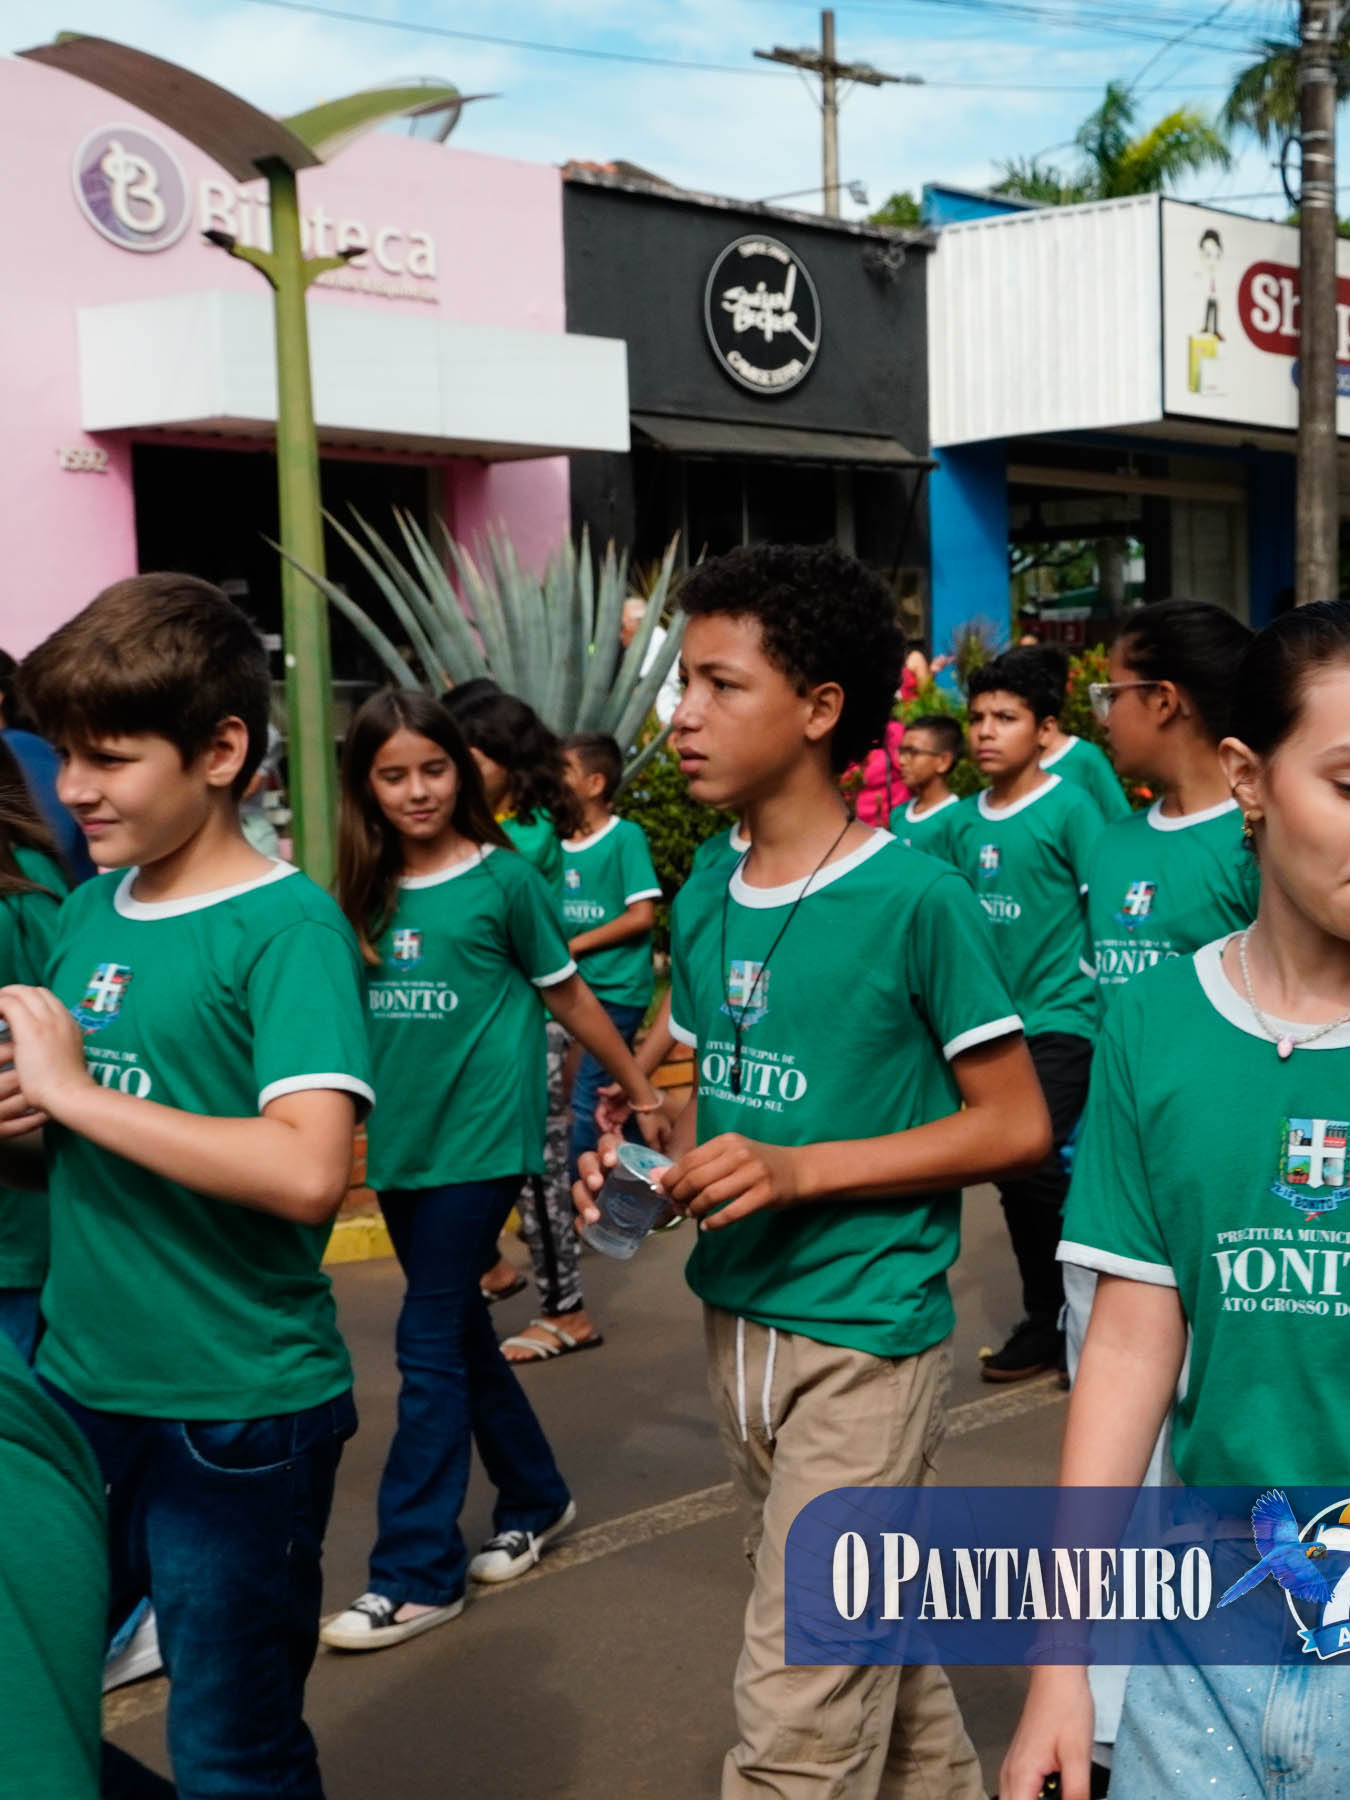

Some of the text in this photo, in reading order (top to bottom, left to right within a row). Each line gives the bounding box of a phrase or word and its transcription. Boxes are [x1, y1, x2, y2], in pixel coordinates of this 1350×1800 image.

[368, 989, 459, 1012] BONITO
[702, 1053, 808, 1101] ONITO
[764, 1100, 784, 1113] SUL
[1222, 1296, 1258, 1313] ATO
[1260, 1297, 1330, 1315] GROSSO
